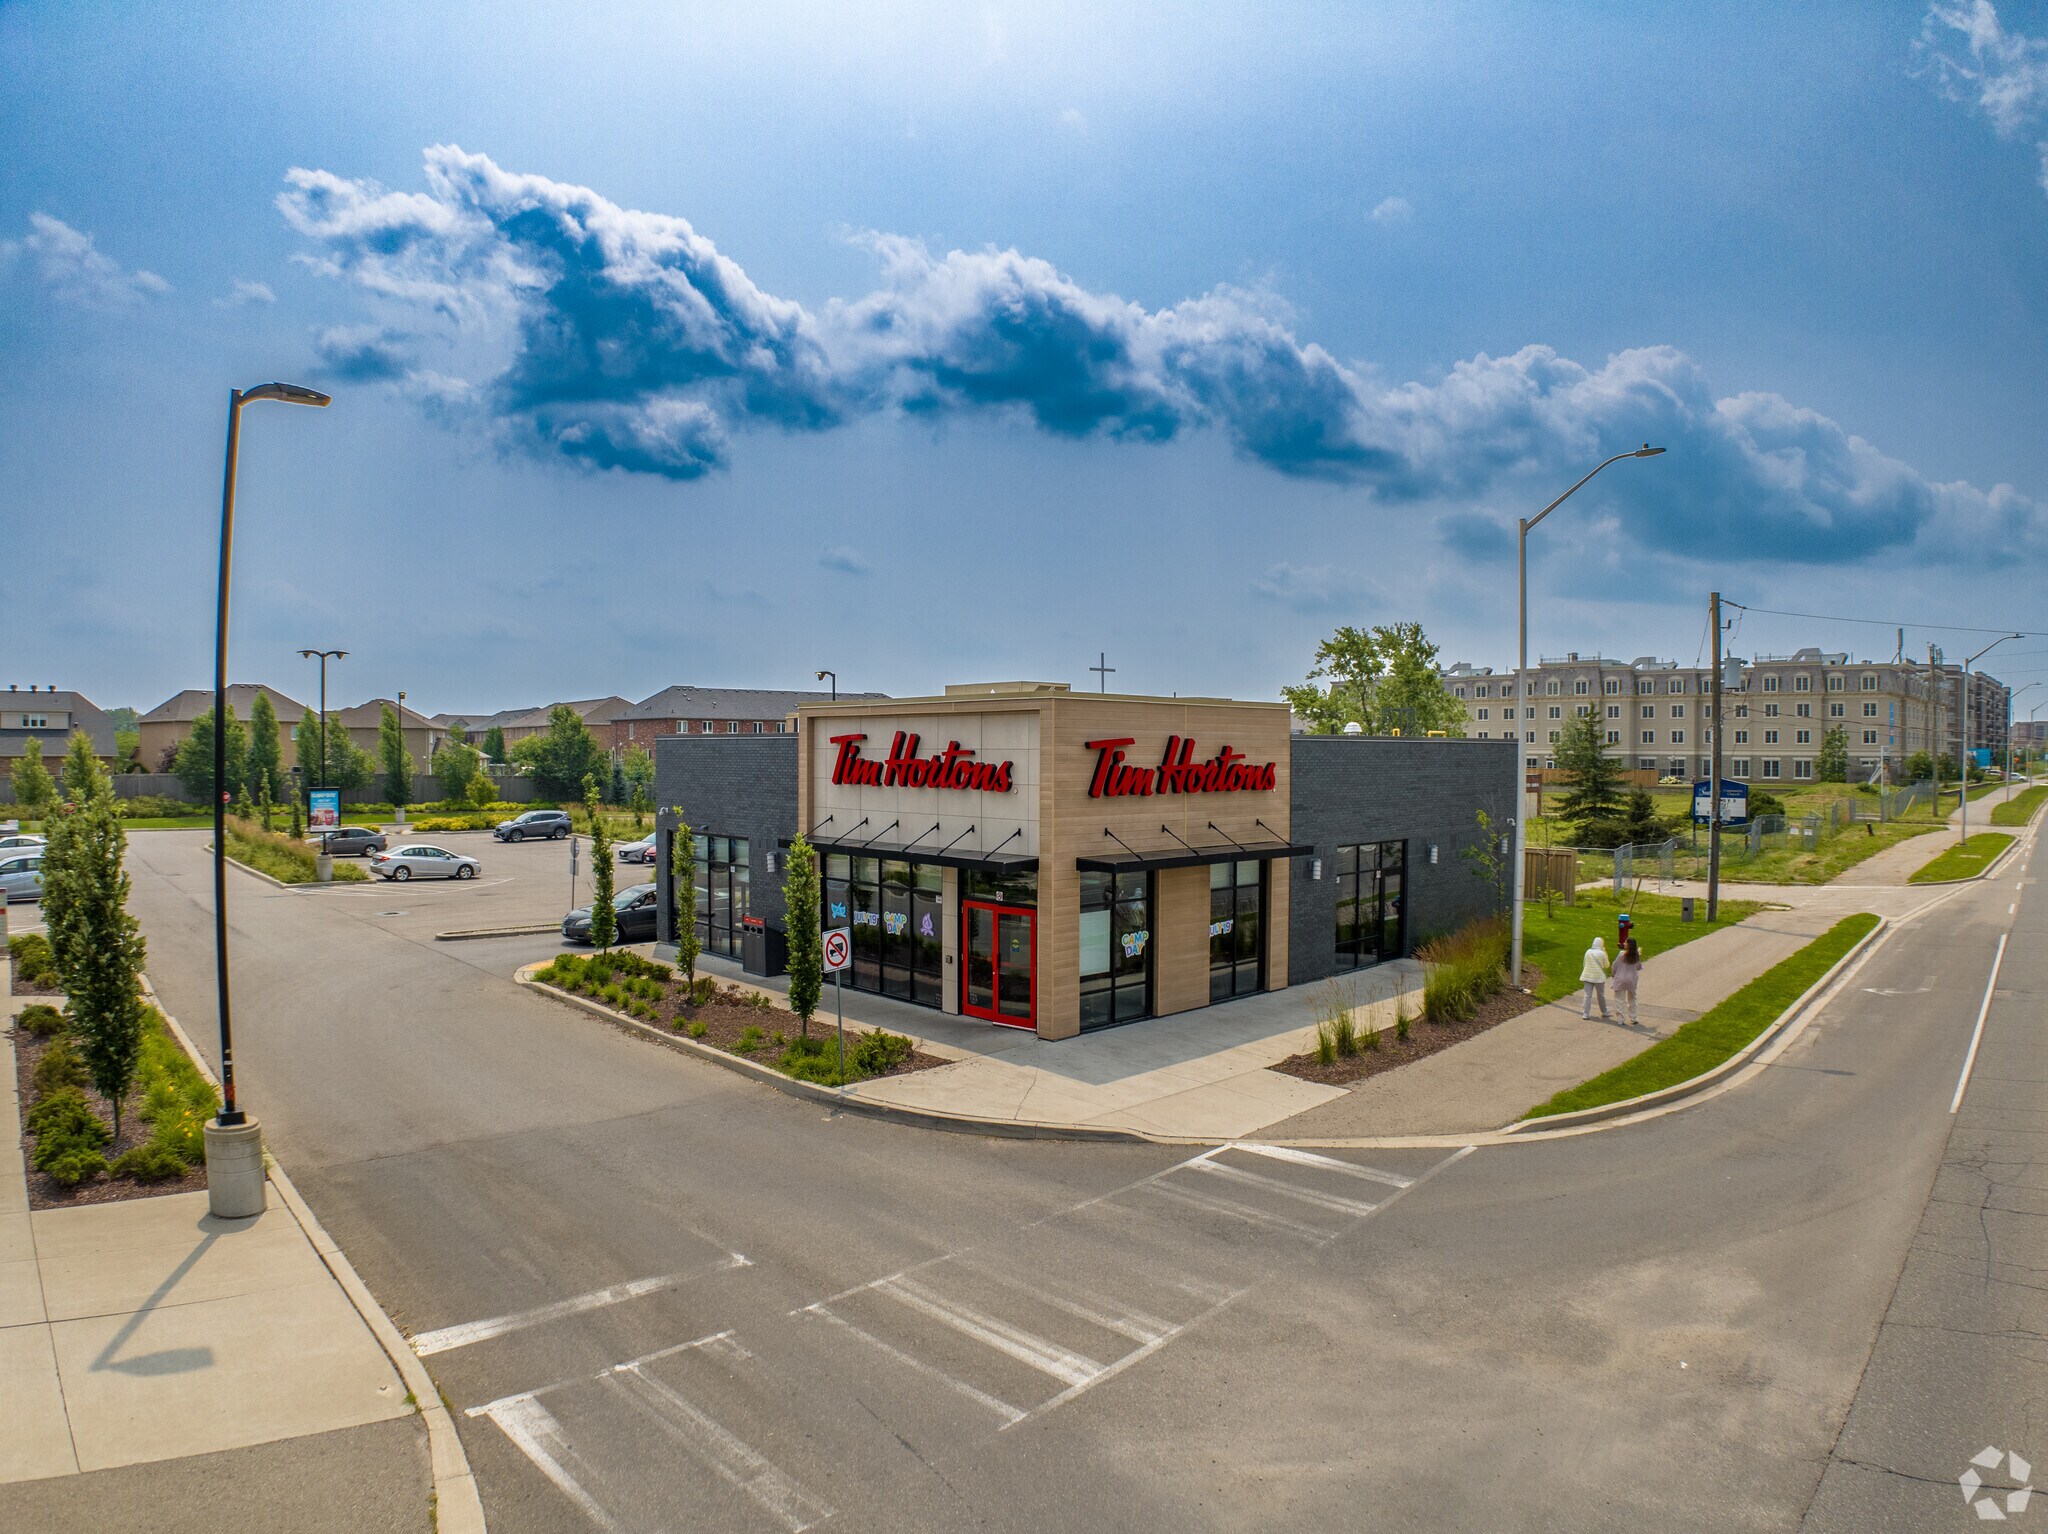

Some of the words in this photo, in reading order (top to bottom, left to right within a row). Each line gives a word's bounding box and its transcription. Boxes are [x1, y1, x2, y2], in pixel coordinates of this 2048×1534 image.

[830, 734, 884, 786] Tim
[884, 731, 1014, 792] Hortons
[1085, 738, 1155, 798] Tim
[1156, 735, 1276, 794] Hortons
[854, 911, 869, 925] JULY
[884, 911, 907, 924] CAMP
[887, 922, 903, 935] DAY
[1210, 922, 1222, 937] ULY
[1122, 931, 1149, 946] CAMP
[1125, 943, 1145, 958] DAY
